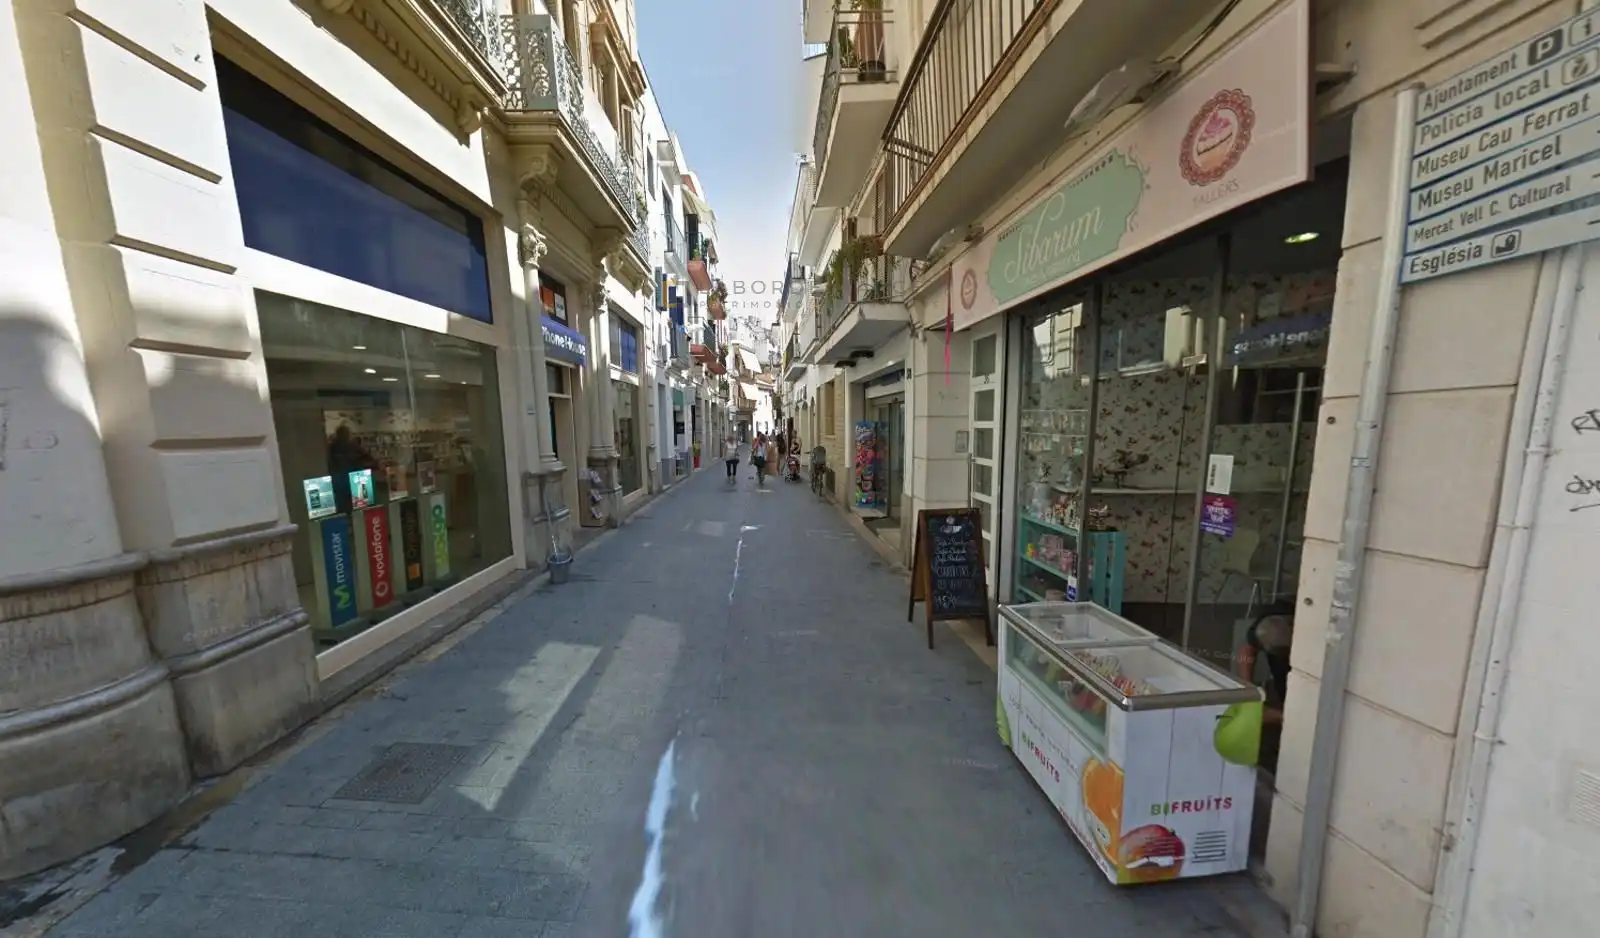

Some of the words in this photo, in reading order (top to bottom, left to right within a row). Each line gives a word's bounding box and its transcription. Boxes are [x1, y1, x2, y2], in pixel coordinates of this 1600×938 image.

[1419, 103, 1484, 145] Policia
[1494, 71, 1550, 111] local
[1424, 53, 1517, 112] Ajuntament
[1416, 145, 1469, 179] Museu
[1478, 127, 1512, 153] Cau
[1522, 91, 1591, 135] Ferrat
[1417, 176, 1474, 211] Museu
[1483, 134, 1563, 185] Maricel
[1413, 218, 1454, 243] Mercat
[1460, 207, 1483, 227] Vell
[1490, 202, 1502, 217] C.
[1508, 175, 1571, 211] Cultural
[1410, 242, 1484, 275] Església
[331, 532, 346, 583] movistar
[372, 515, 386, 578] vodafone
